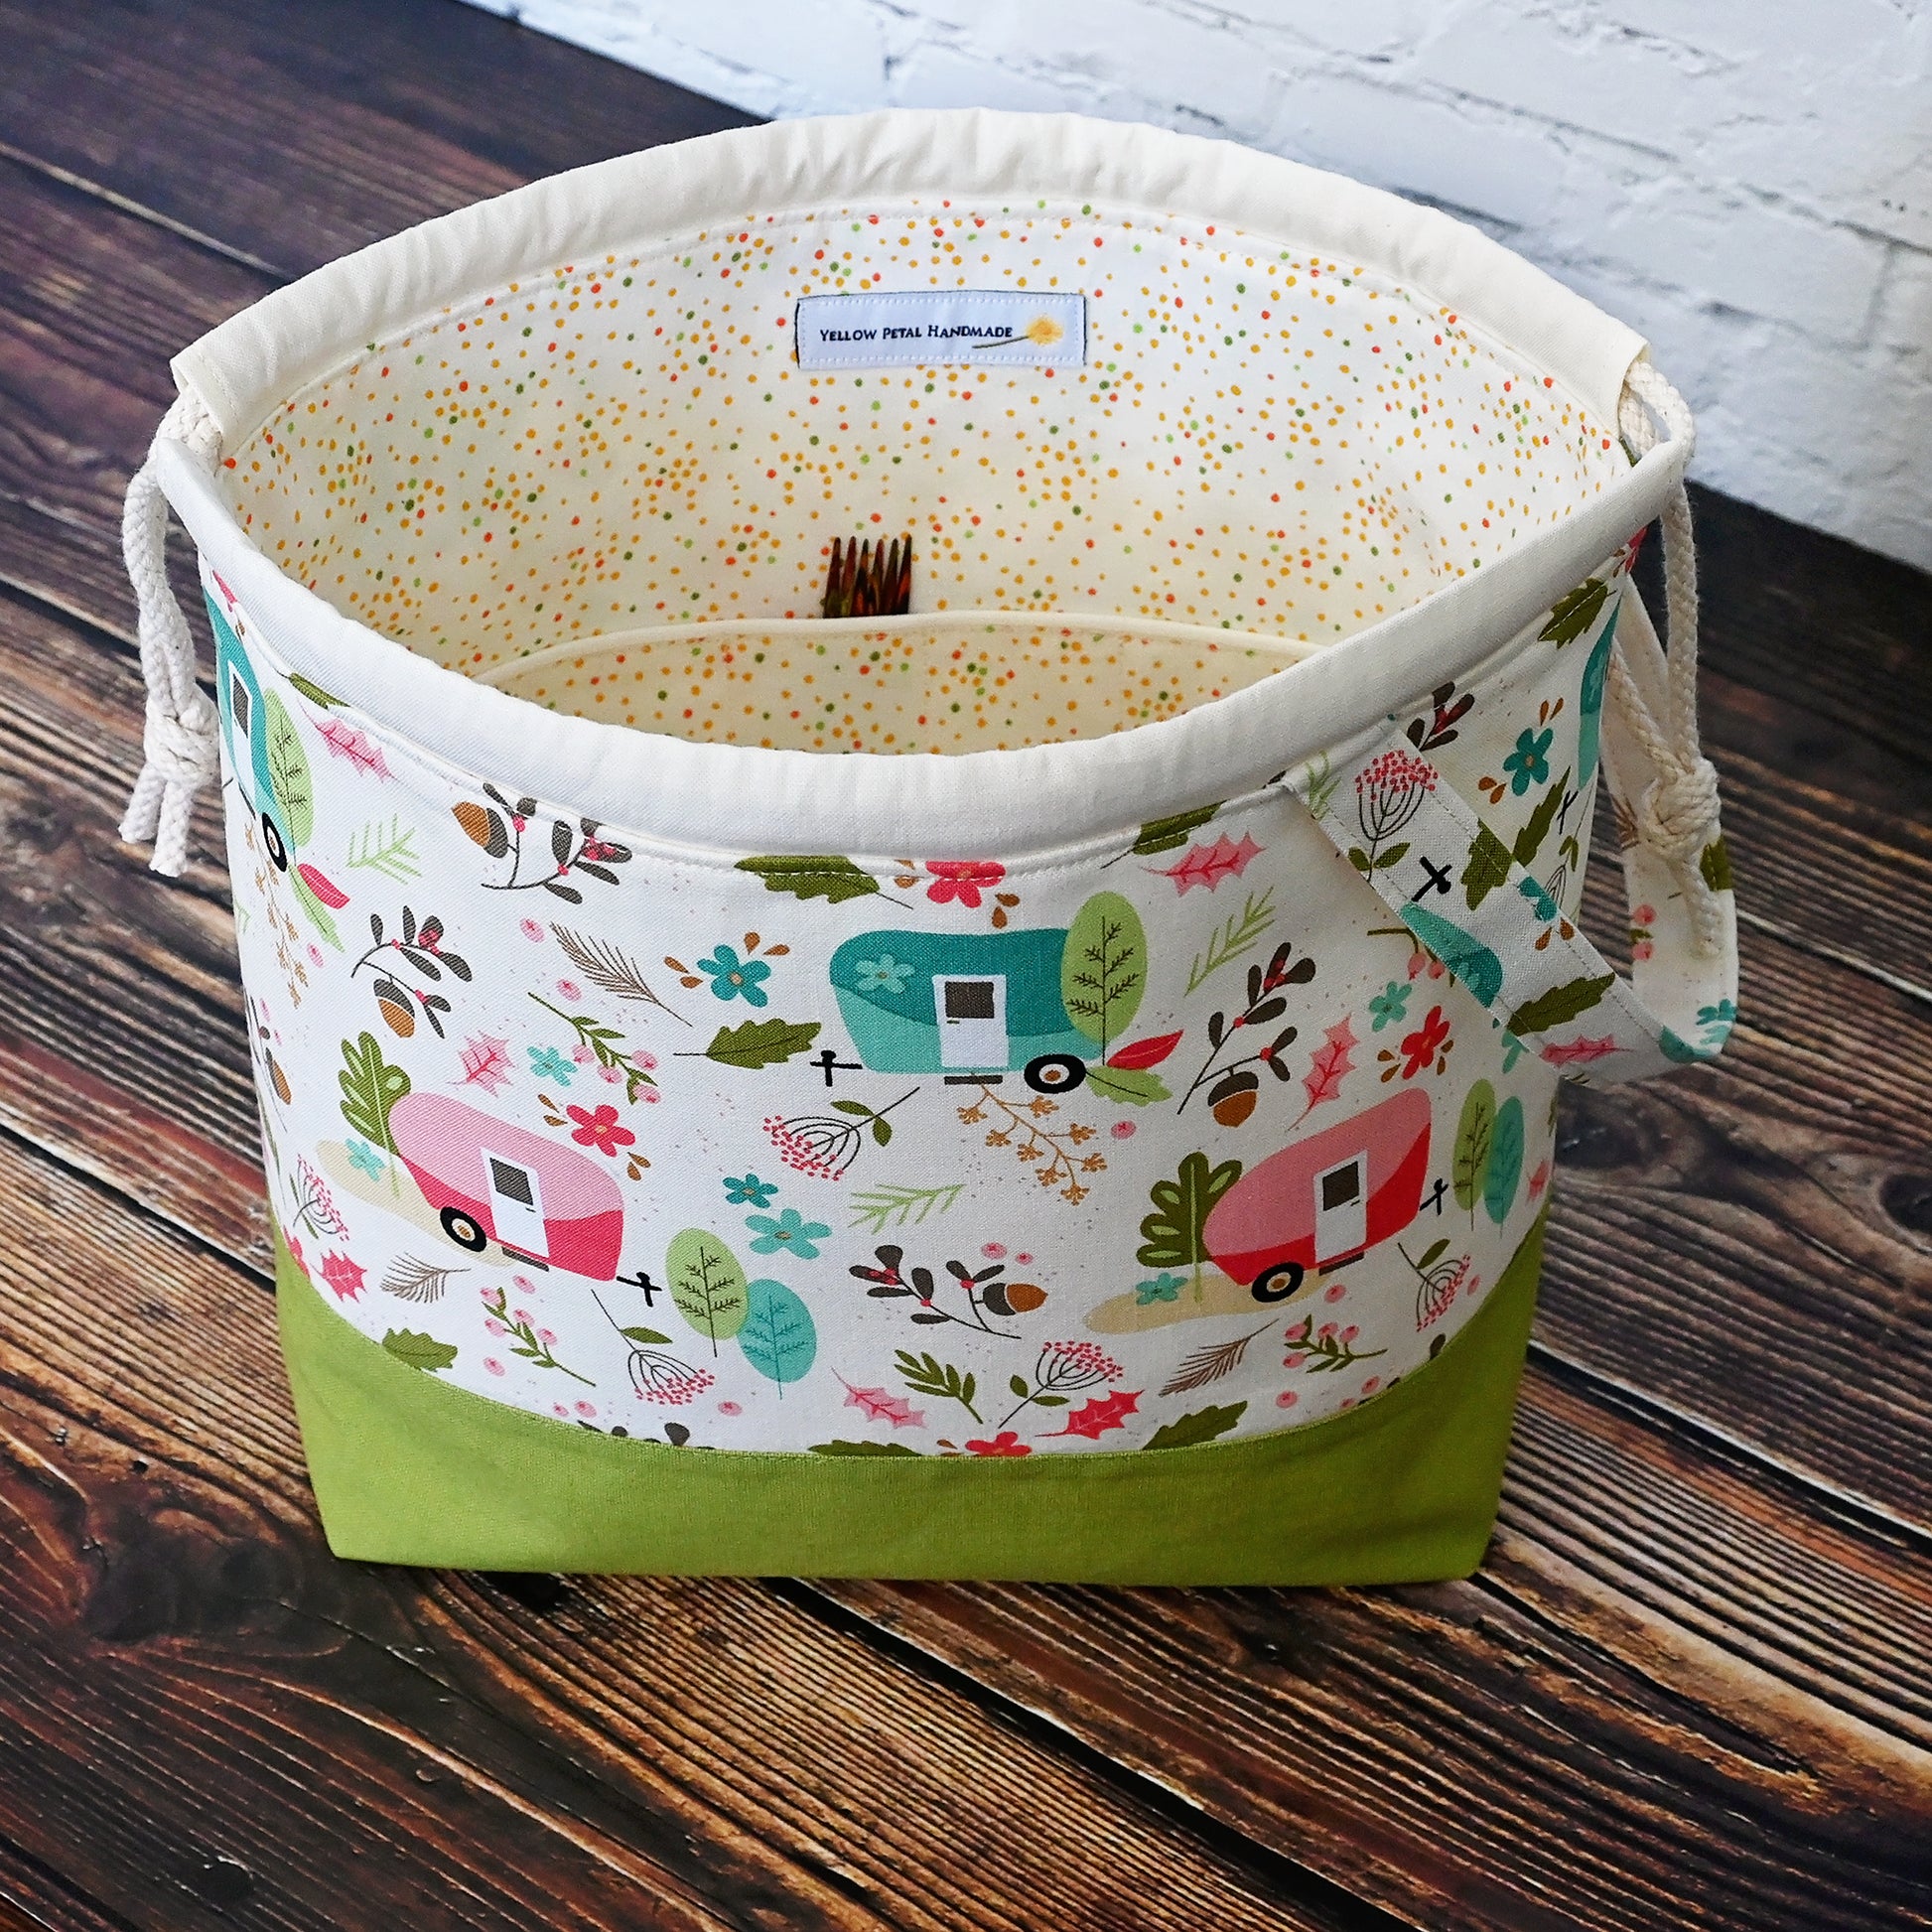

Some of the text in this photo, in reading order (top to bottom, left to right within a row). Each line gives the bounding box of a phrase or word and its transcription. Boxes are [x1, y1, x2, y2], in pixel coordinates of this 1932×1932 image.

[819, 325, 1013, 342] YELLOW PETAL HANDMADE
